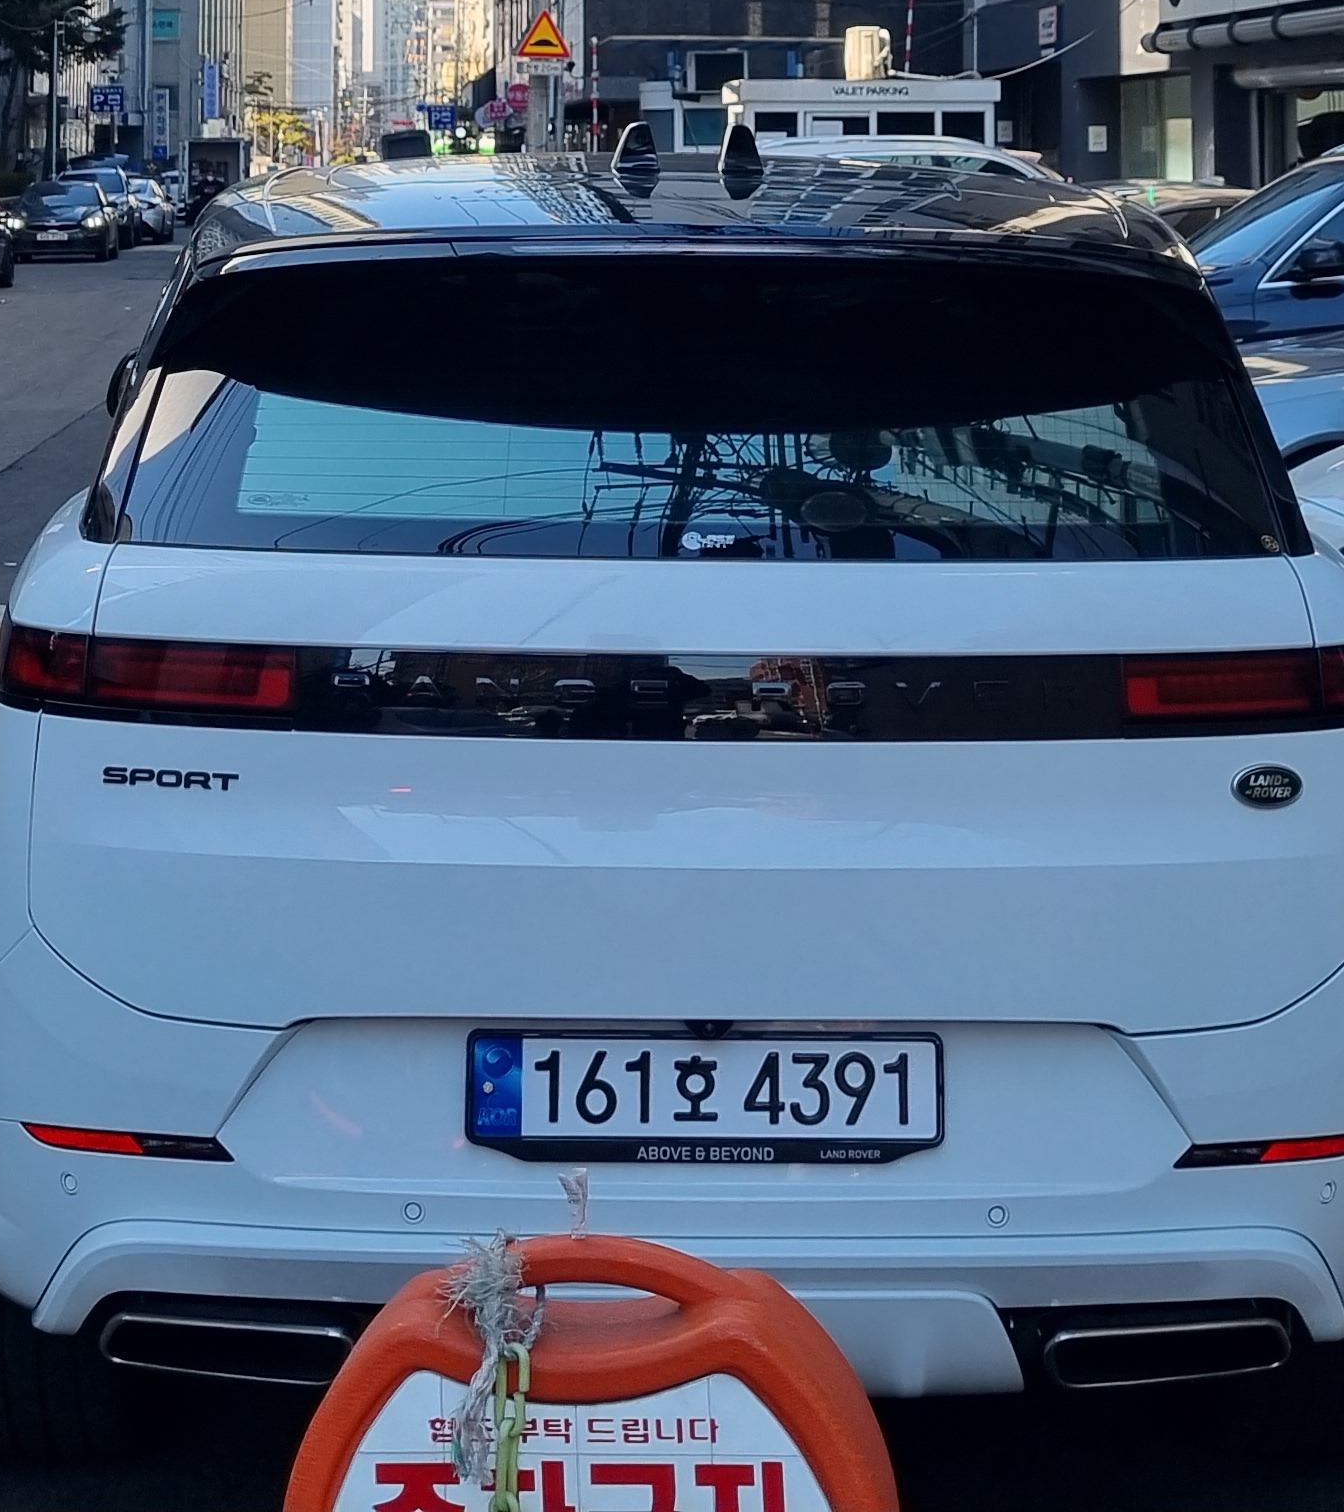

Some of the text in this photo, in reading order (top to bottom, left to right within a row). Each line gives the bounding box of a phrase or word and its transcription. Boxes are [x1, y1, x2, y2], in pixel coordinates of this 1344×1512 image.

[833, 86, 909, 97] VALET PARKING
[102, 766, 240, 791] SPORT
[1249, 774, 1283, 787] LAND
[1252, 787, 1293, 798] ROVER
[533, 1048, 910, 1126] 161호 4391
[637, 1145, 775, 1161] ABOVE & BEYOND
[820, 1149, 881, 1159] LAND ROVER
[586, 1417, 719, 1445] 드립니다
